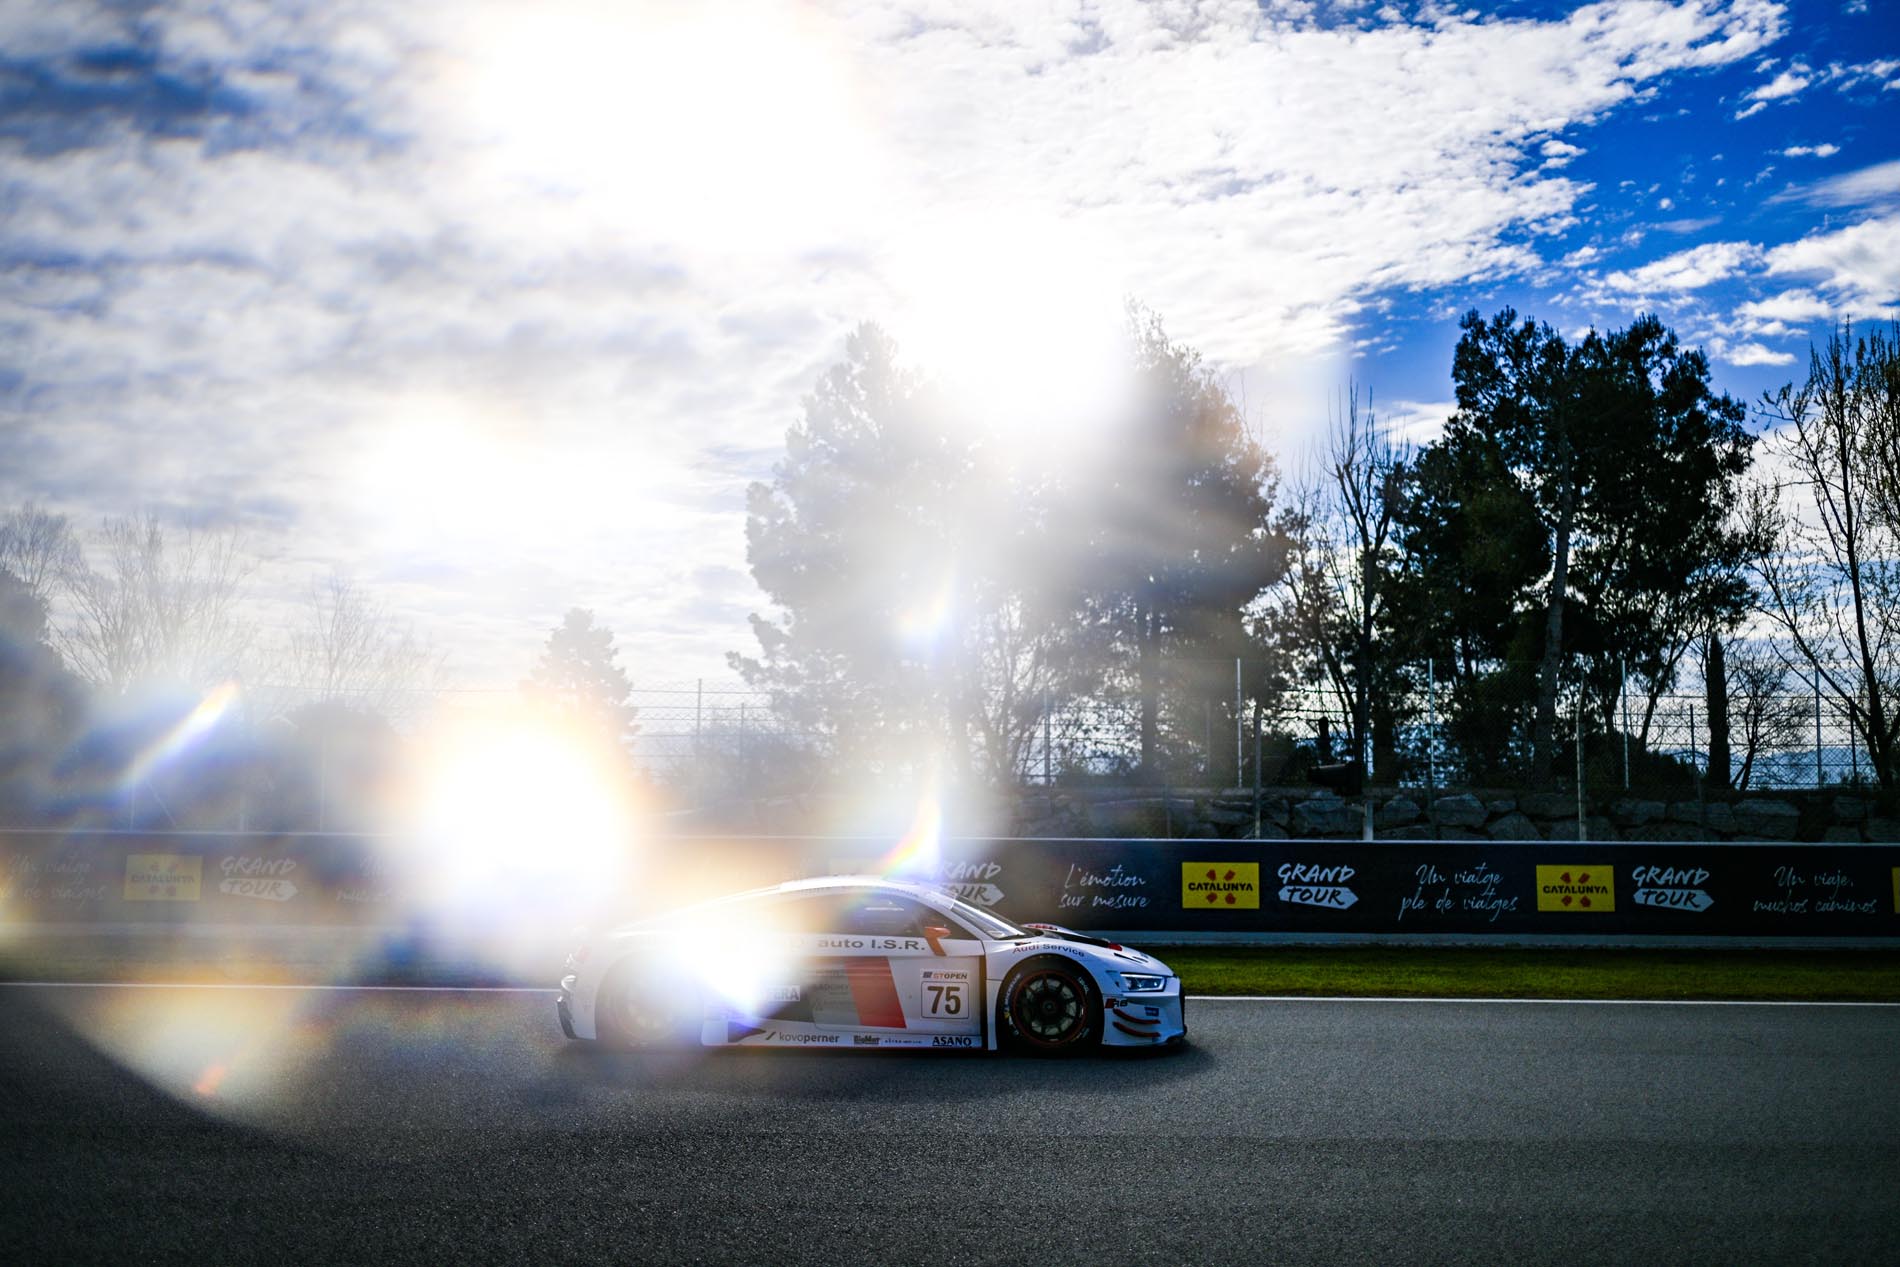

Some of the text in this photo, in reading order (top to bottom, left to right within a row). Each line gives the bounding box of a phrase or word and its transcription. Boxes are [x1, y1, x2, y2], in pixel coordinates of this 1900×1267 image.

[219, 855, 297, 876] GRAND
[1277, 863, 1355, 884] GRAND
[1064, 863, 1145, 889] L'émotion
[1416, 862, 1503, 896] Un viatge
[1632, 866, 1710, 887] GRAND
[1774, 866, 1805, 887] Un
[230, 881, 281, 897] TOUR
[1188, 882, 1253, 892] CATALUNYA
[1286, 887, 1346, 906] TOUR
[1543, 885, 1608, 894] CATALUNYA
[1058, 893, 1148, 909] sur mesure
[1398, 887, 1518, 922] ple de viatges
[1641, 889, 1701, 909] TOUR
[1753, 888, 1877, 914] muchos caminos
[817, 938, 926, 951] auto I.S.R.
[1012, 943, 1085, 958] Audi Service
[927, 985, 961, 1015] 75
[779, 1032, 840, 1044] kovoperner
[932, 1036, 972, 1046] ASANO
